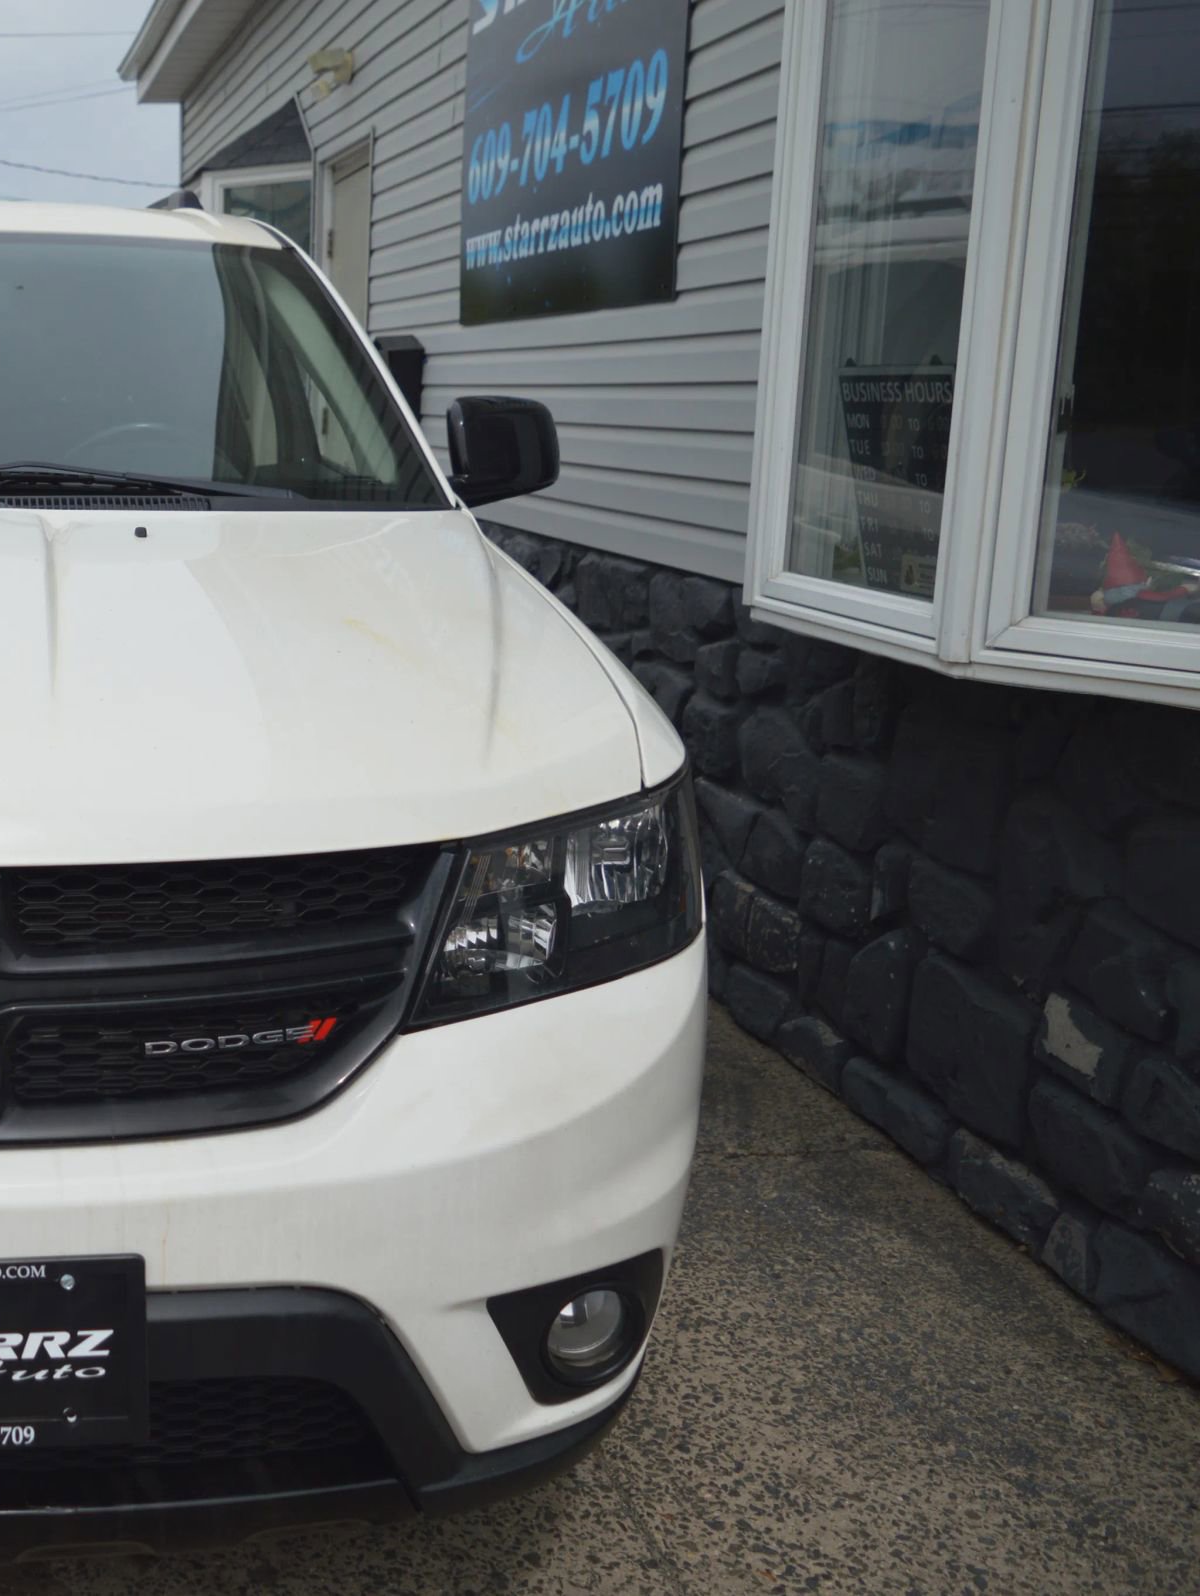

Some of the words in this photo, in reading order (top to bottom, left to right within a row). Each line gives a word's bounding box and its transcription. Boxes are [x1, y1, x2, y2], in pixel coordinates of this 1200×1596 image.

[467, 48, 668, 206] 609-704-5709
[465, 182, 664, 270] www.starrzauto.com
[841, 381, 901, 402] BUSINESS
[903, 381, 953, 404] HOURS
[846, 413, 870, 429] MON
[908, 418, 921, 432] TO
[849, 439, 871, 455] TUE
[911, 445, 924, 459] TO
[915, 472, 928, 487] TO
[863, 541, 882, 559] SAT
[866, 565, 888, 584] SUN
[144, 1025, 314, 1055] DODGE
